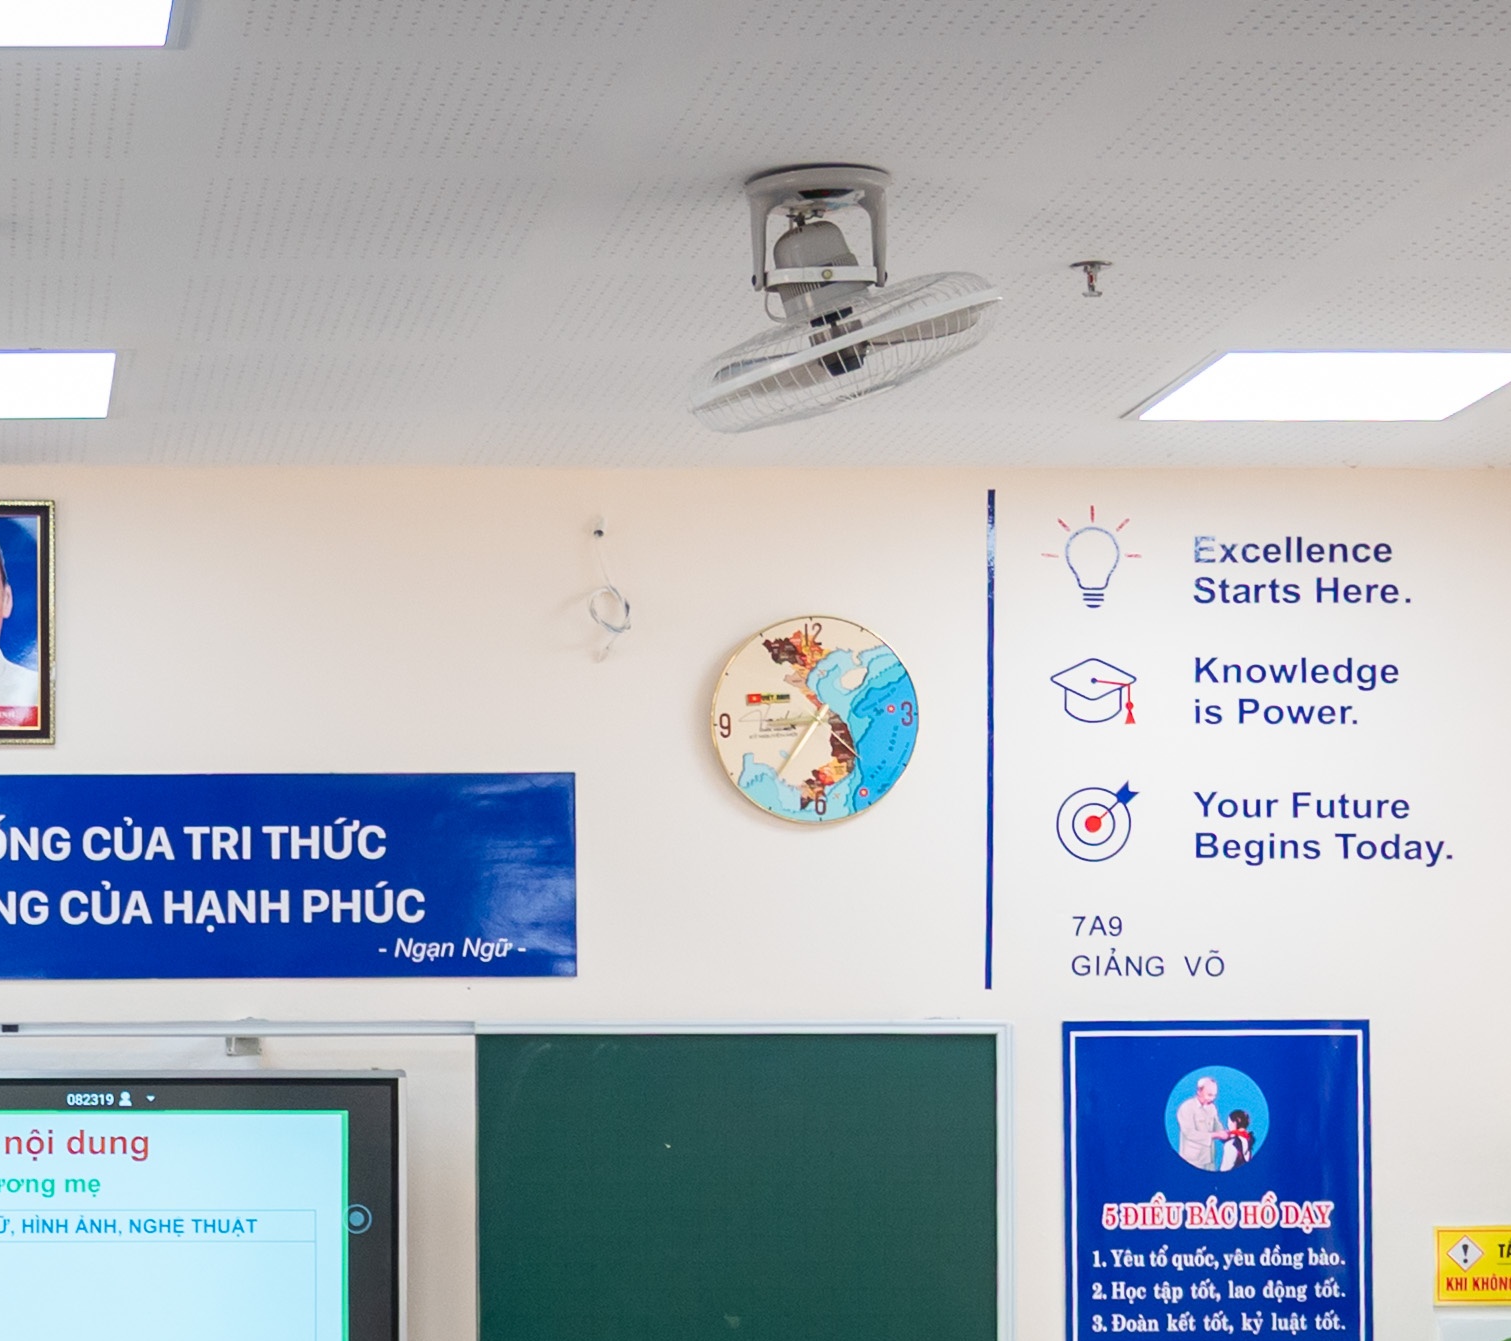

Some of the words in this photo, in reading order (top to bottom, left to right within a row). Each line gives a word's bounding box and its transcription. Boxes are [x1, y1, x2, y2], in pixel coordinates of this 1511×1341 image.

[1194, 536, 1392, 563] Excellence
[1194, 577, 1300, 603] Starts
[1316, 577, 1411, 603] Here.
[804, 622, 823, 647] 12
[1195, 657, 1398, 691] Knowledge
[901, 701, 913, 727] 3
[1195, 699, 1222, 724] is
[1239, 699, 1357, 724] Power.
[719, 713, 732, 739] 9
[1194, 792, 1278, 818] Your
[1293, 792, 1409, 819] Future
[83, 818, 175, 861] CỦA
[183, 826, 251, 860] TRI
[262, 817, 386, 859] THỨC
[1196, 833, 1320, 866] Begins
[1335, 833, 1452, 867] Today.
[60, 881, 152, 925] CỦA
[164, 890, 289, 932] HẠNH
[303, 881, 425, 923] PHÚC
[1072, 915, 1123, 937] 7A9
[395, 938, 454, 962] Ngạn
[463, 938, 513, 962] Ngữ
[1072, 948, 1164, 977] GIẢNG
[1184, 950, 1224, 977] VÕ
[67, 1094, 114, 1105] 082319
[6, 1130, 52, 1161] nội
[67, 1130, 148, 1161] dung
[65, 1179, 100, 1197] mẹ
[1102, 1202, 1119, 1230] 5
[1120, 1191, 1183, 1230] ĐIỀU
[1185, 1194, 1237, 1229] BÁC
[1239, 1190, 1278, 1228] HỒ
[1280, 1200, 1334, 1234] DẠY
[22, 1215, 68, 1233] HÌNH
[76, 1216, 121, 1234] ẢNH,
[130, 1216, 184, 1237] NGHỆ
[192, 1216, 257, 1237] THUẬT
[1093, 1251, 1106, 1267] 1.
[1111, 1249, 1145, 1267] Yêu
[1150, 1245, 1168, 1267] tổ
[1172, 1246, 1219, 1270] quốc,
[1223, 1248, 1255, 1270] yêu
[1260, 1245, 1304, 1269] đồng
[1308, 1248, 1345, 1265] bào.
[1092, 1283, 1107, 1299] 2.
[1112, 1282, 1146, 1304] Học
[1154, 1281, 1183, 1304] tập
[1191, 1279, 1221, 1302] tốt,
[1228, 1280, 1255, 1298] lao
[1263, 1280, 1307, 1303] động
[1315, 1277, 1345, 1297] tốt.
[1446, 1277, 1468, 1291] KHI
[1092, 1315, 1107, 1332] 3.
[1112, 1314, 1159, 1332] Đoàn
[1167, 1312, 1196, 1331] kết
[1203, 1311, 1233, 1334] tốt,
[1242, 1311, 1263, 1334] kỷ
[1272, 1313, 1307, 1335] luật
[1315, 1310, 1345, 1330] tốt.
